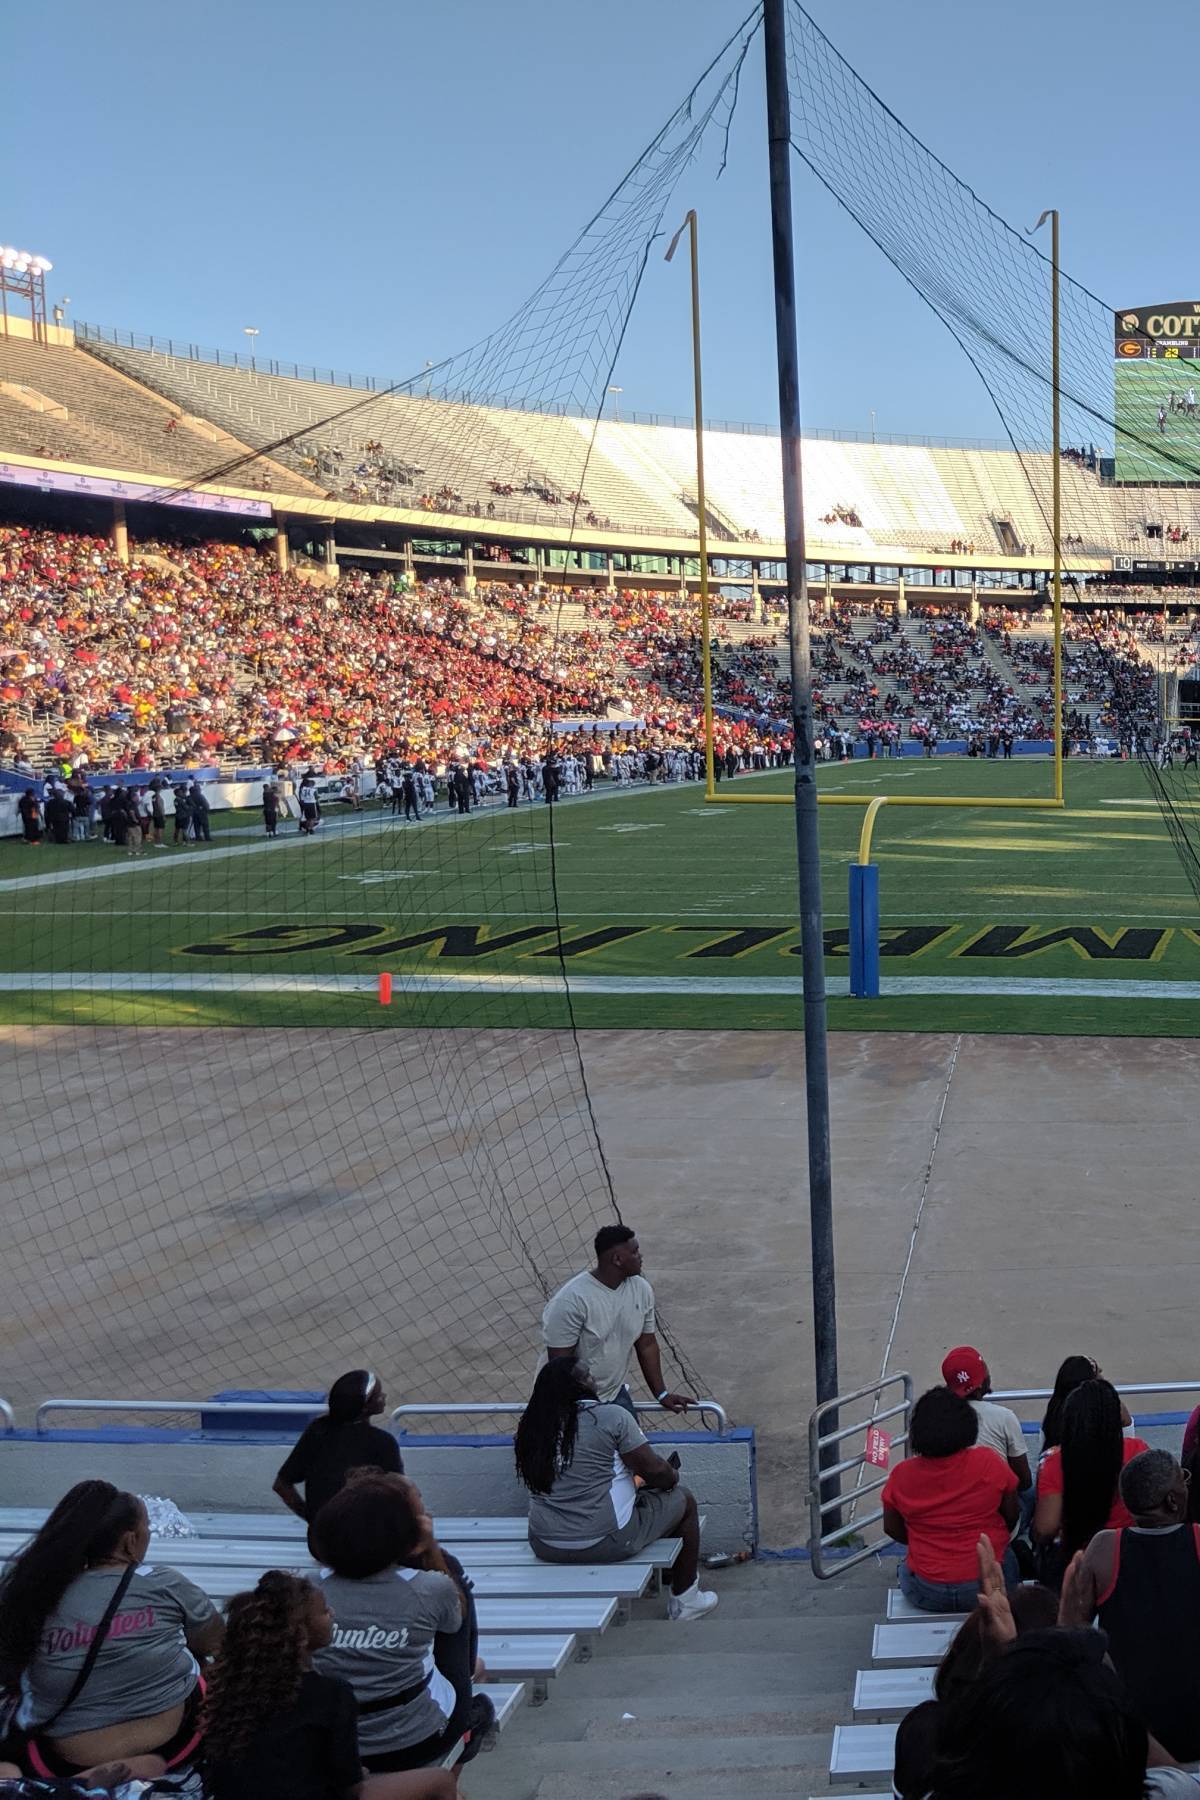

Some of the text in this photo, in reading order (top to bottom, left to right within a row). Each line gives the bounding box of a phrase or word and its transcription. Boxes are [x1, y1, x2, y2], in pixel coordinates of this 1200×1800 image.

[1120, 557, 1131, 569] 10
[878, 1436, 886, 1461] ENTRY
[47, 1605, 155, 1655] Voluteer
[330, 1623, 409, 1648] lunteer
